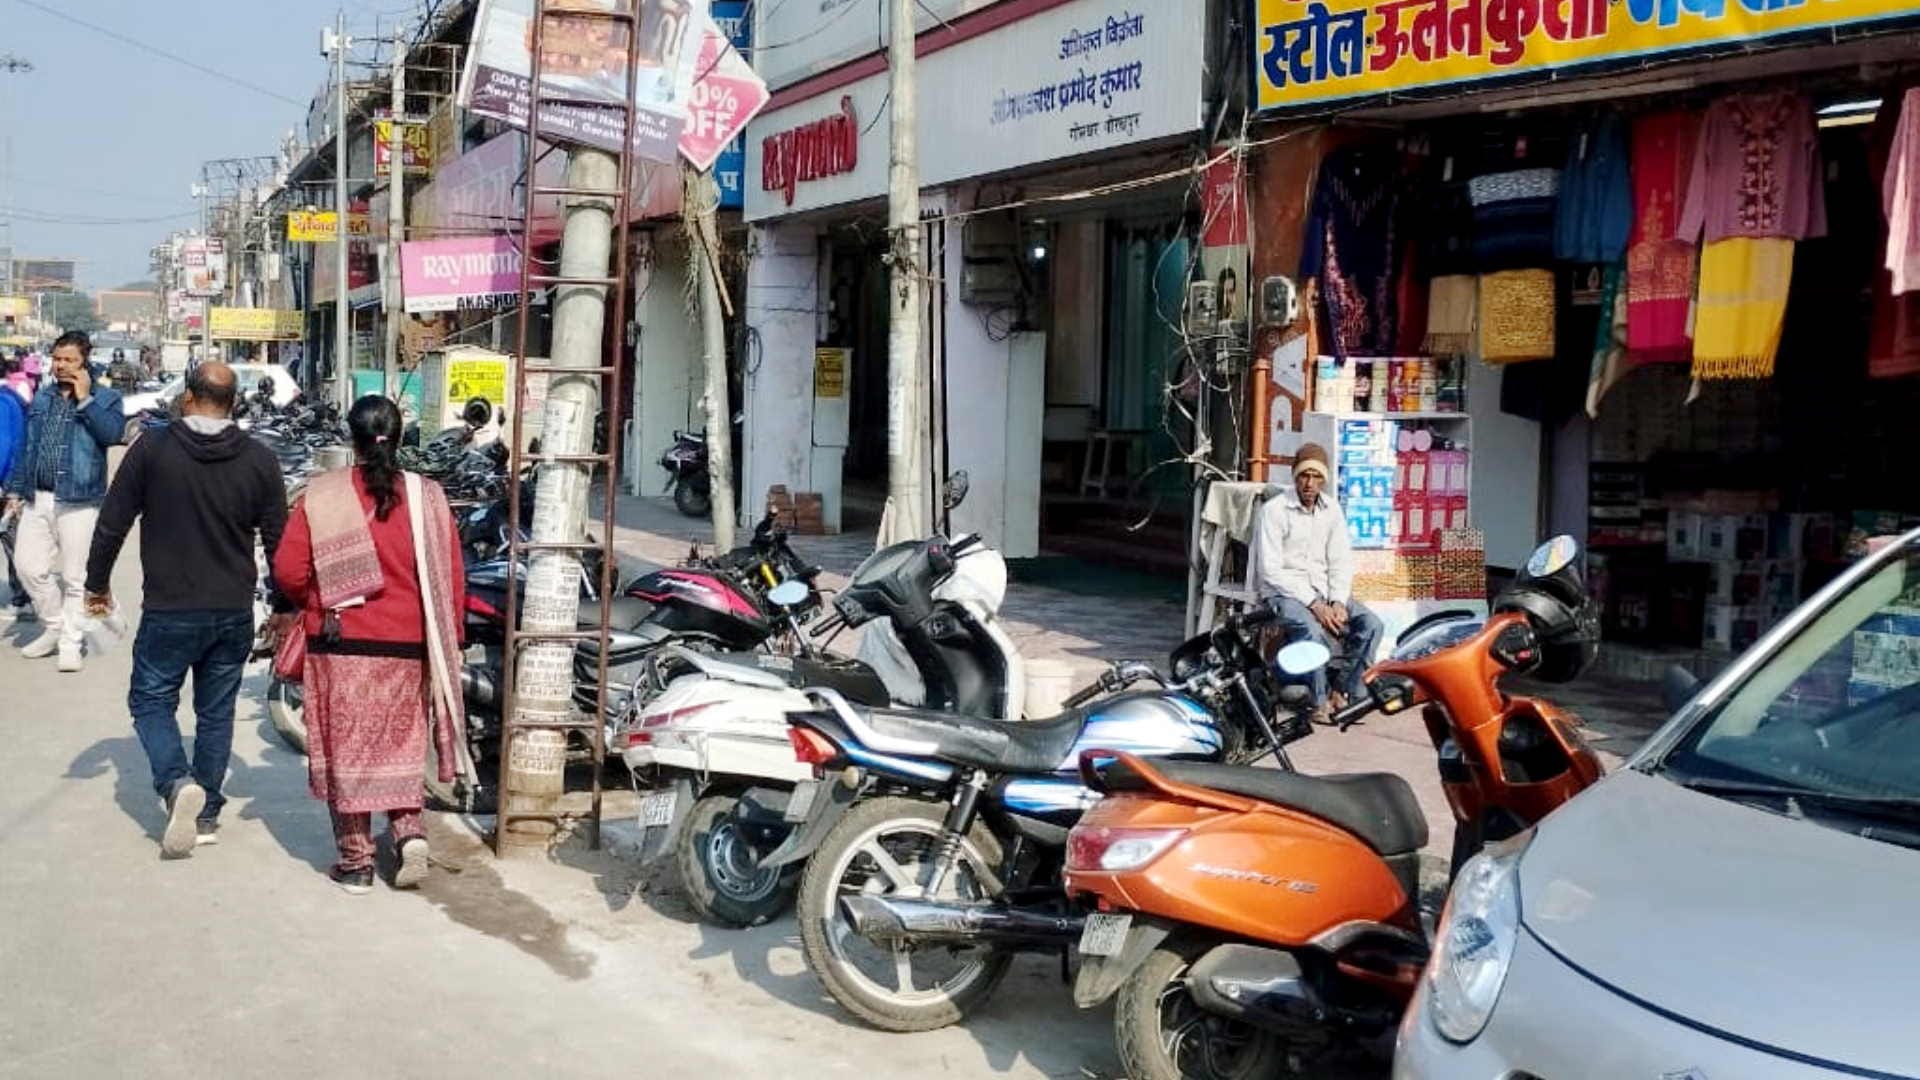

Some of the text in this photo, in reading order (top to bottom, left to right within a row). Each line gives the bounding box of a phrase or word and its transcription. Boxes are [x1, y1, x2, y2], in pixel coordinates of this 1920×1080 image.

[1059, 10, 1144, 60] अधिकृत विक्रेता
[1263, 2, 1367, 88] स्टोल
[690, 81, 737, 111] 0%
[1059, 68, 1097, 111] प्रमोद
[1100, 61, 1142, 109] कुमार
[456, 292, 536, 310] AKASHDEP
